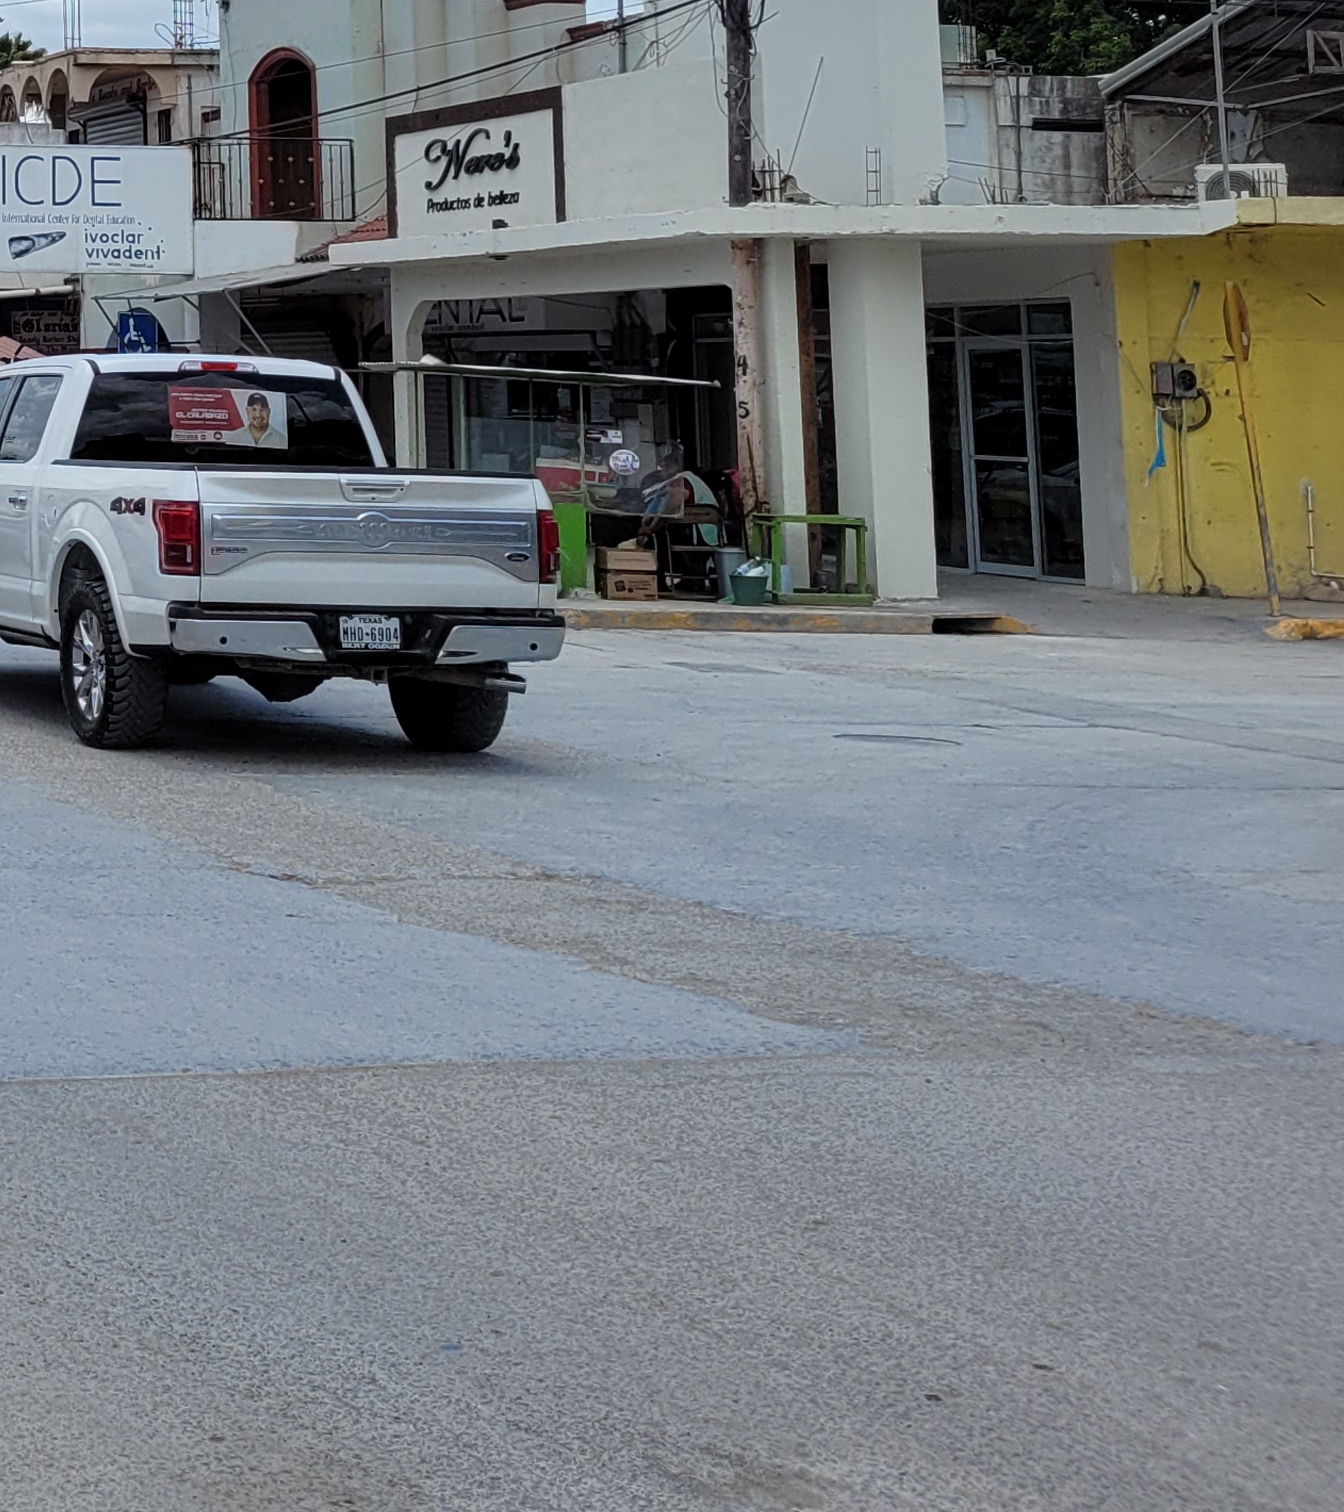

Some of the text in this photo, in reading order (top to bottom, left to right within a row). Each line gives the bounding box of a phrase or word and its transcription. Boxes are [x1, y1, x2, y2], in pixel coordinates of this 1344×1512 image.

[1, 154, 122, 207] ICDE
[426, 190, 520, 214] Productos de belleza
[1, 212, 46, 224] International
[47, 213, 70, 225] Center
[82, 214, 105, 226] Dental
[106, 214, 135, 225] Education
[84, 228, 144, 245] ivoclar
[84, 244, 161, 261] vivadent
[424, 298, 526, 325] NTAL
[736, 354, 748, 377] 4
[737, 400, 750, 419] 5
